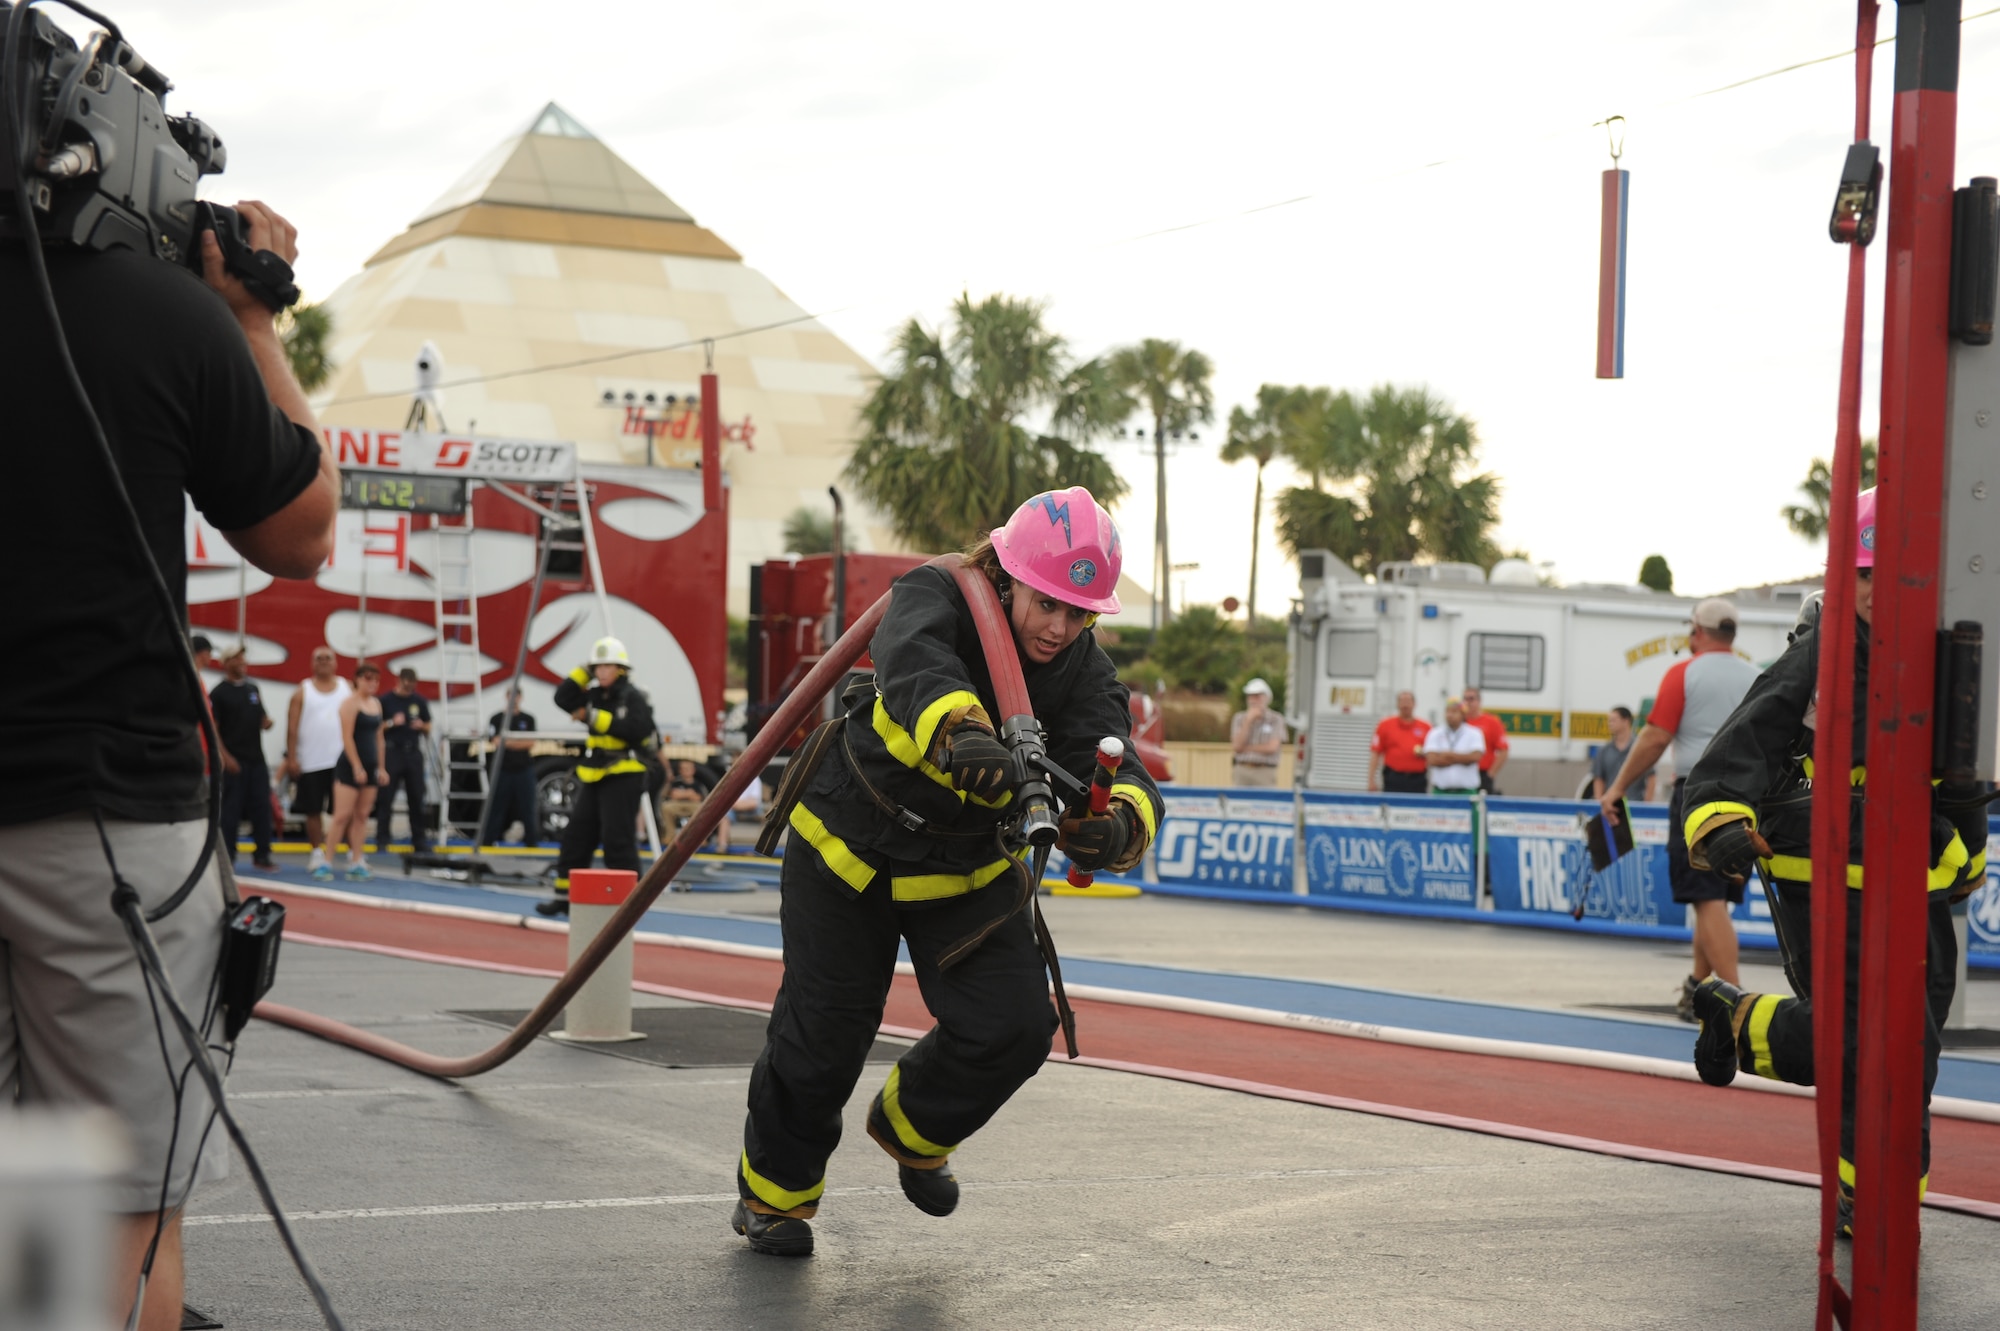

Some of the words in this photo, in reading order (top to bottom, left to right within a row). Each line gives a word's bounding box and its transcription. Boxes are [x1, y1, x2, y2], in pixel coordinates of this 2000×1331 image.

[623, 406, 693, 440] Hard
[477, 441, 563, 463] SCOTT
[1200, 821, 1294, 866] SCOTT
[1339, 836, 1386, 868] LION
[1420, 841, 1471, 873] LION
[1198, 864, 1283, 888] SAFETY
[1422, 880, 1473, 902] APPAREL
[1517, 836, 1569, 913] FIRE
[1565, 839, 1659, 921] RESCUE
